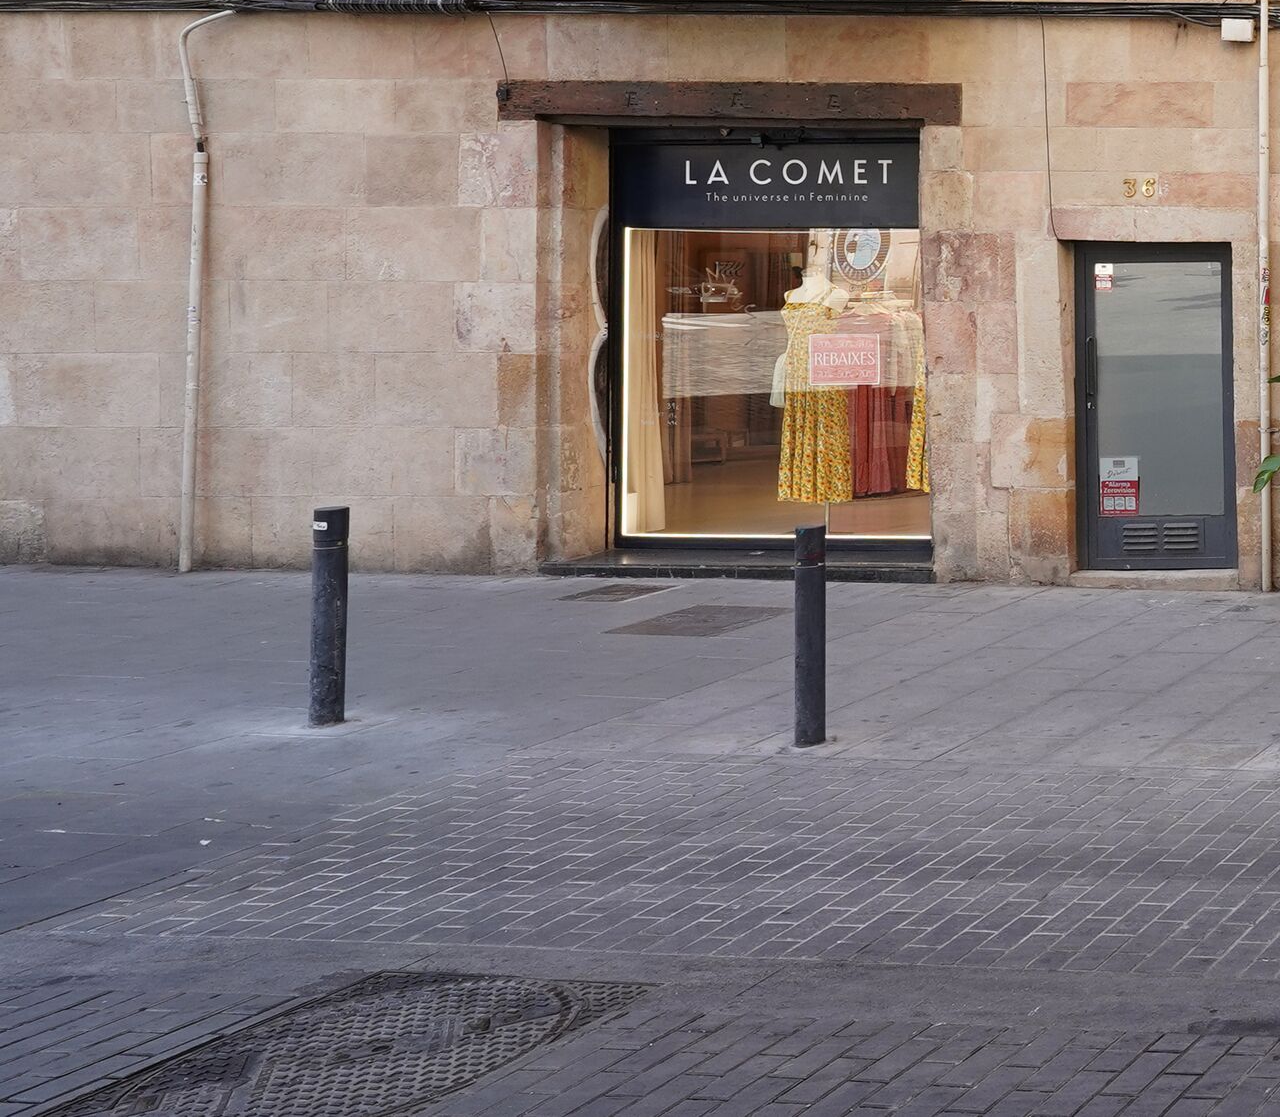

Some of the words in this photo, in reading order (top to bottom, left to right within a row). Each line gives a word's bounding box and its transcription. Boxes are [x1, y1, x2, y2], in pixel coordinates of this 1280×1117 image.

[685, 159, 729, 185] LA
[749, 158, 893, 185] COMET
[1122, 177, 1156, 198] 36
[706, 191, 729, 203] The
[732, 192, 789, 203] universe
[793, 191, 806, 203] in
[808, 191, 869, 203] Feminine
[813, 351, 876, 366] REBAIXES
